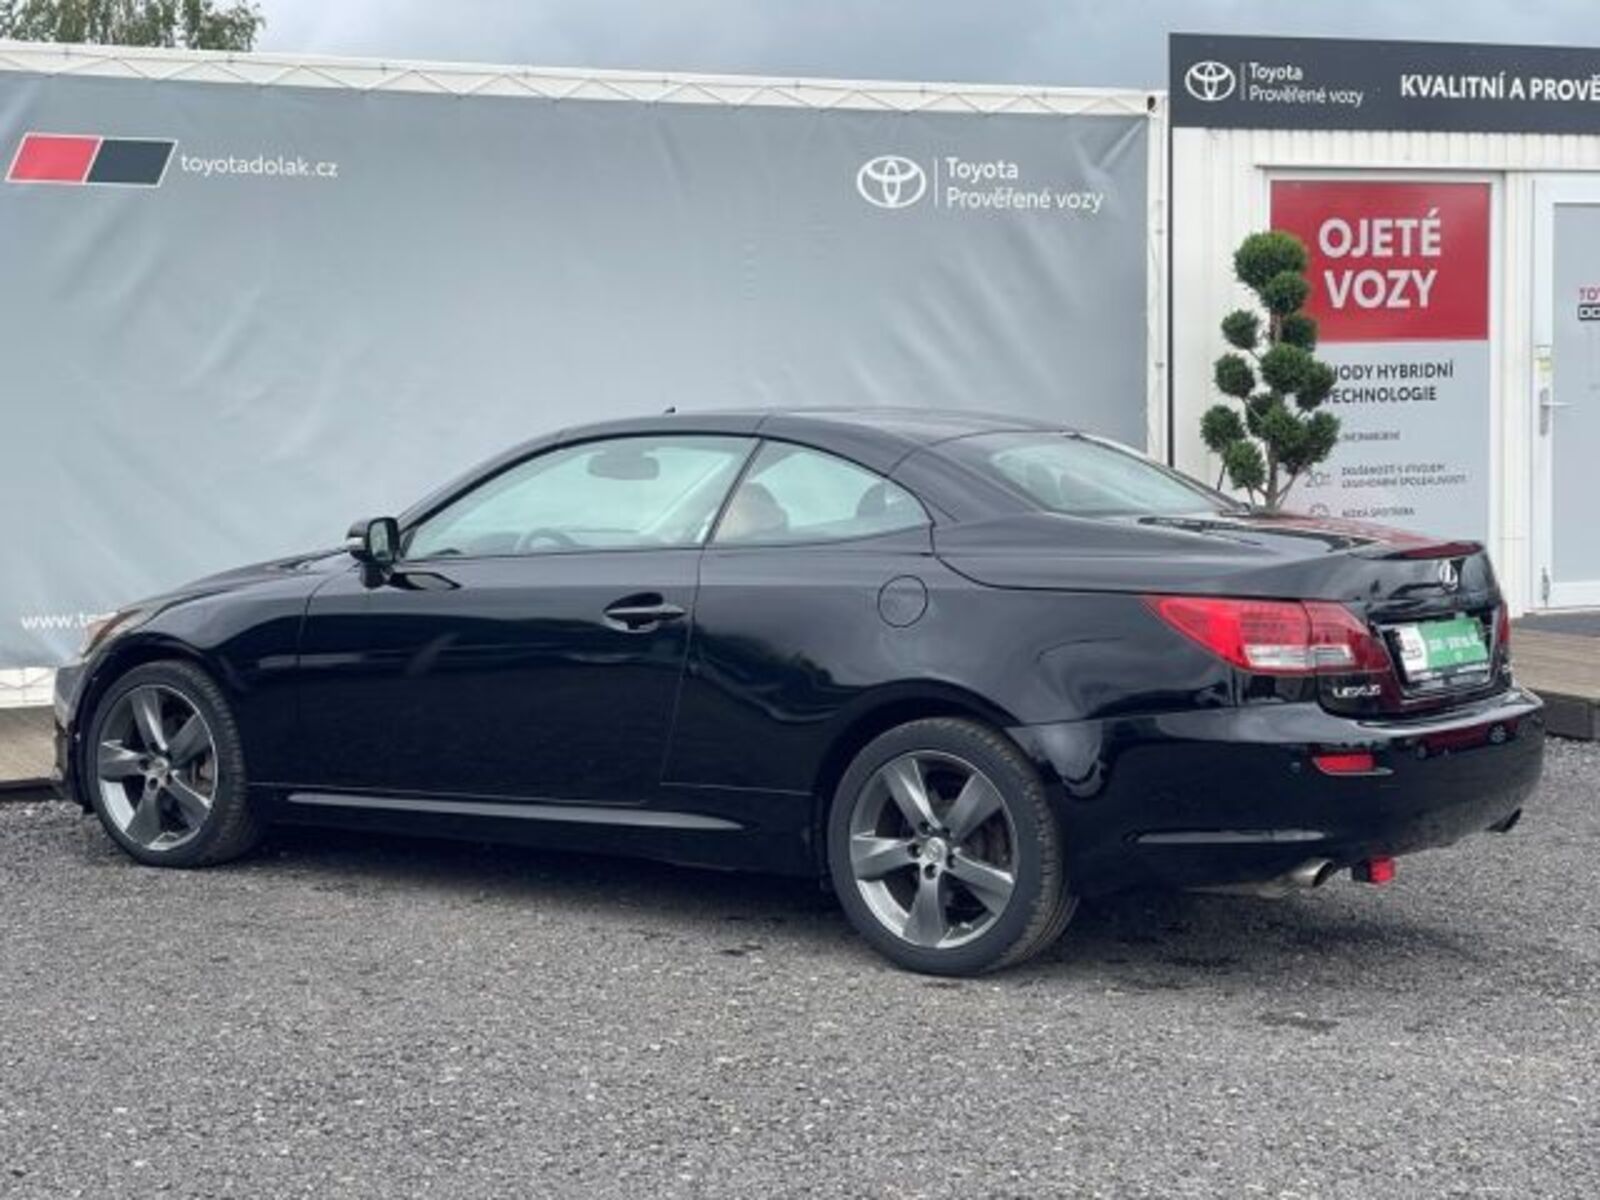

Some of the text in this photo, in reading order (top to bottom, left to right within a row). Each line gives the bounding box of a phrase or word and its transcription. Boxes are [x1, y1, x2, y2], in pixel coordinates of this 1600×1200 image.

[1250, 62, 1303, 82] Toyota
[1250, 84, 1364, 108] Prověřené vozy
[1400, 70, 1506, 99] KVALITNÍ
[1508, 77, 1526, 100] A
[180, 154, 339, 177] toyotadolak.cz
[946, 157, 1019, 182] Toyota
[947, 186, 1104, 213] Prověřené vozy
[1318, 208, 1441, 258] OJETÉ
[1324, 269, 1437, 309] VOZY
[1377, 360, 1453, 379] HYBRIDNÍ
